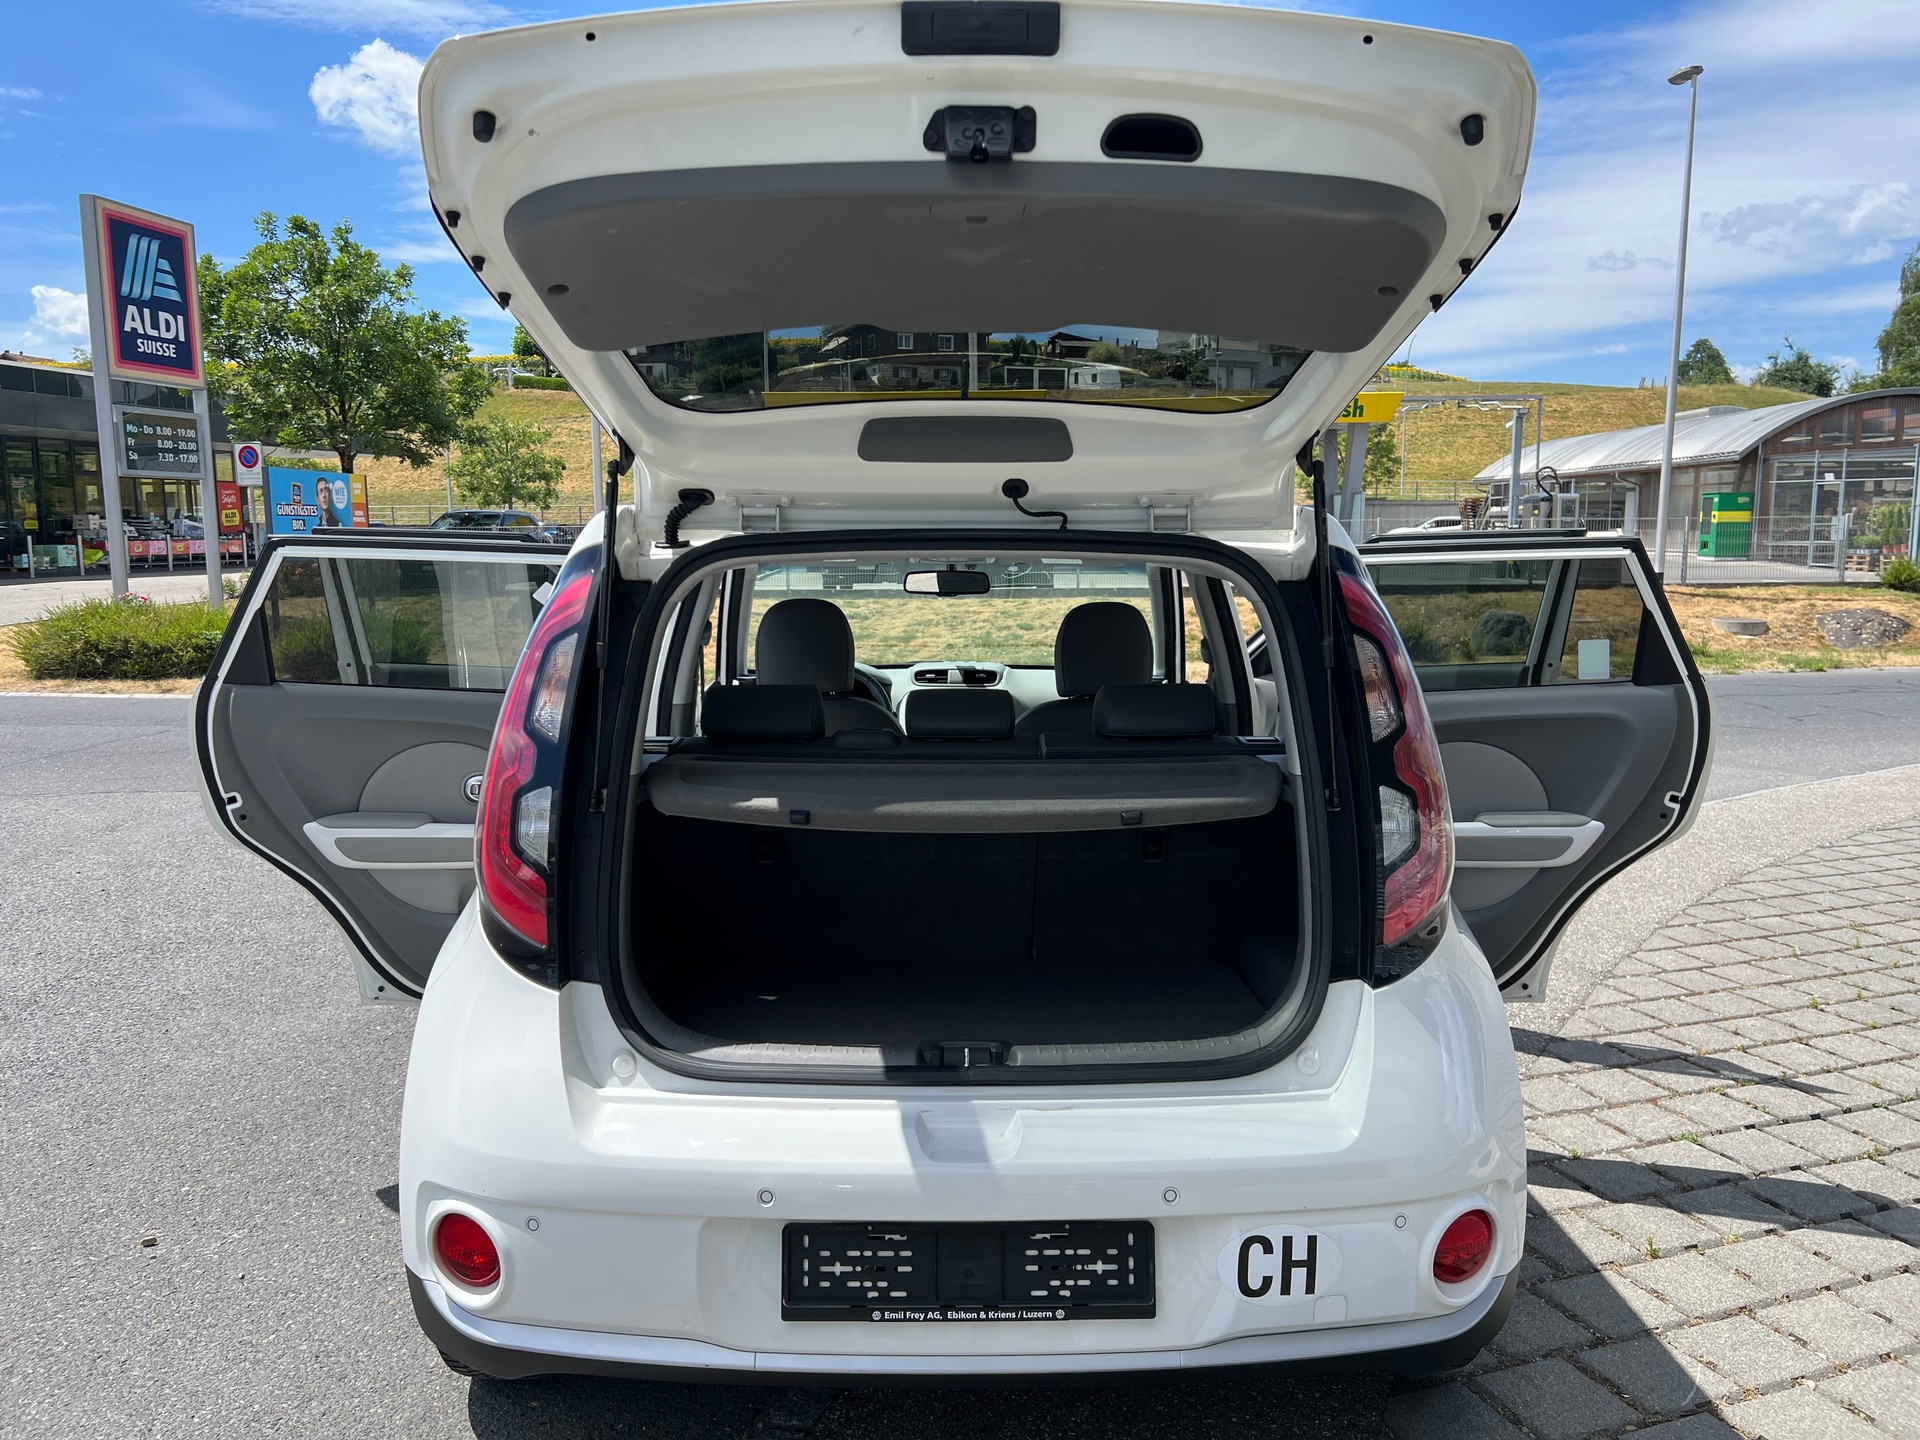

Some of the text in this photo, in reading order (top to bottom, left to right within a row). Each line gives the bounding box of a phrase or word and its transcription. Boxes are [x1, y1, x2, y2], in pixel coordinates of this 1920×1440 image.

[124, 304, 185, 342] ALDI
[136, 338, 177, 358] SUISSE
[126, 423, 138, 433] Mo
[143, 425, 154, 434] Do
[156, 426, 172, 436] 8.00
[177, 428, 196, 438] 19.00
[127, 437, 135, 446] Fr
[157, 439, 173, 449] 8.00
[178, 441, 197, 450] 20.00
[128, 450, 138, 460] Sa
[158, 453, 174, 462] 7.30
[179, 454, 198, 463] 17.00
[277, 502, 318, 516] GÜNSTIGSTES
[292, 519, 306, 530] BIO.
[1237, 1234, 1318, 1298] CH
[884, 1310, 904, 1319] Emil
[906, 1311, 925, 1321] Frey
[927, 1311, 943, 1320] AG,
[947, 1310, 977, 1319] Ebikon
[979, 1311, 987, 1319] &
[988, 1310, 1016, 1319] Kriens
[1022, 1310, 1053, 1318] Luzern
